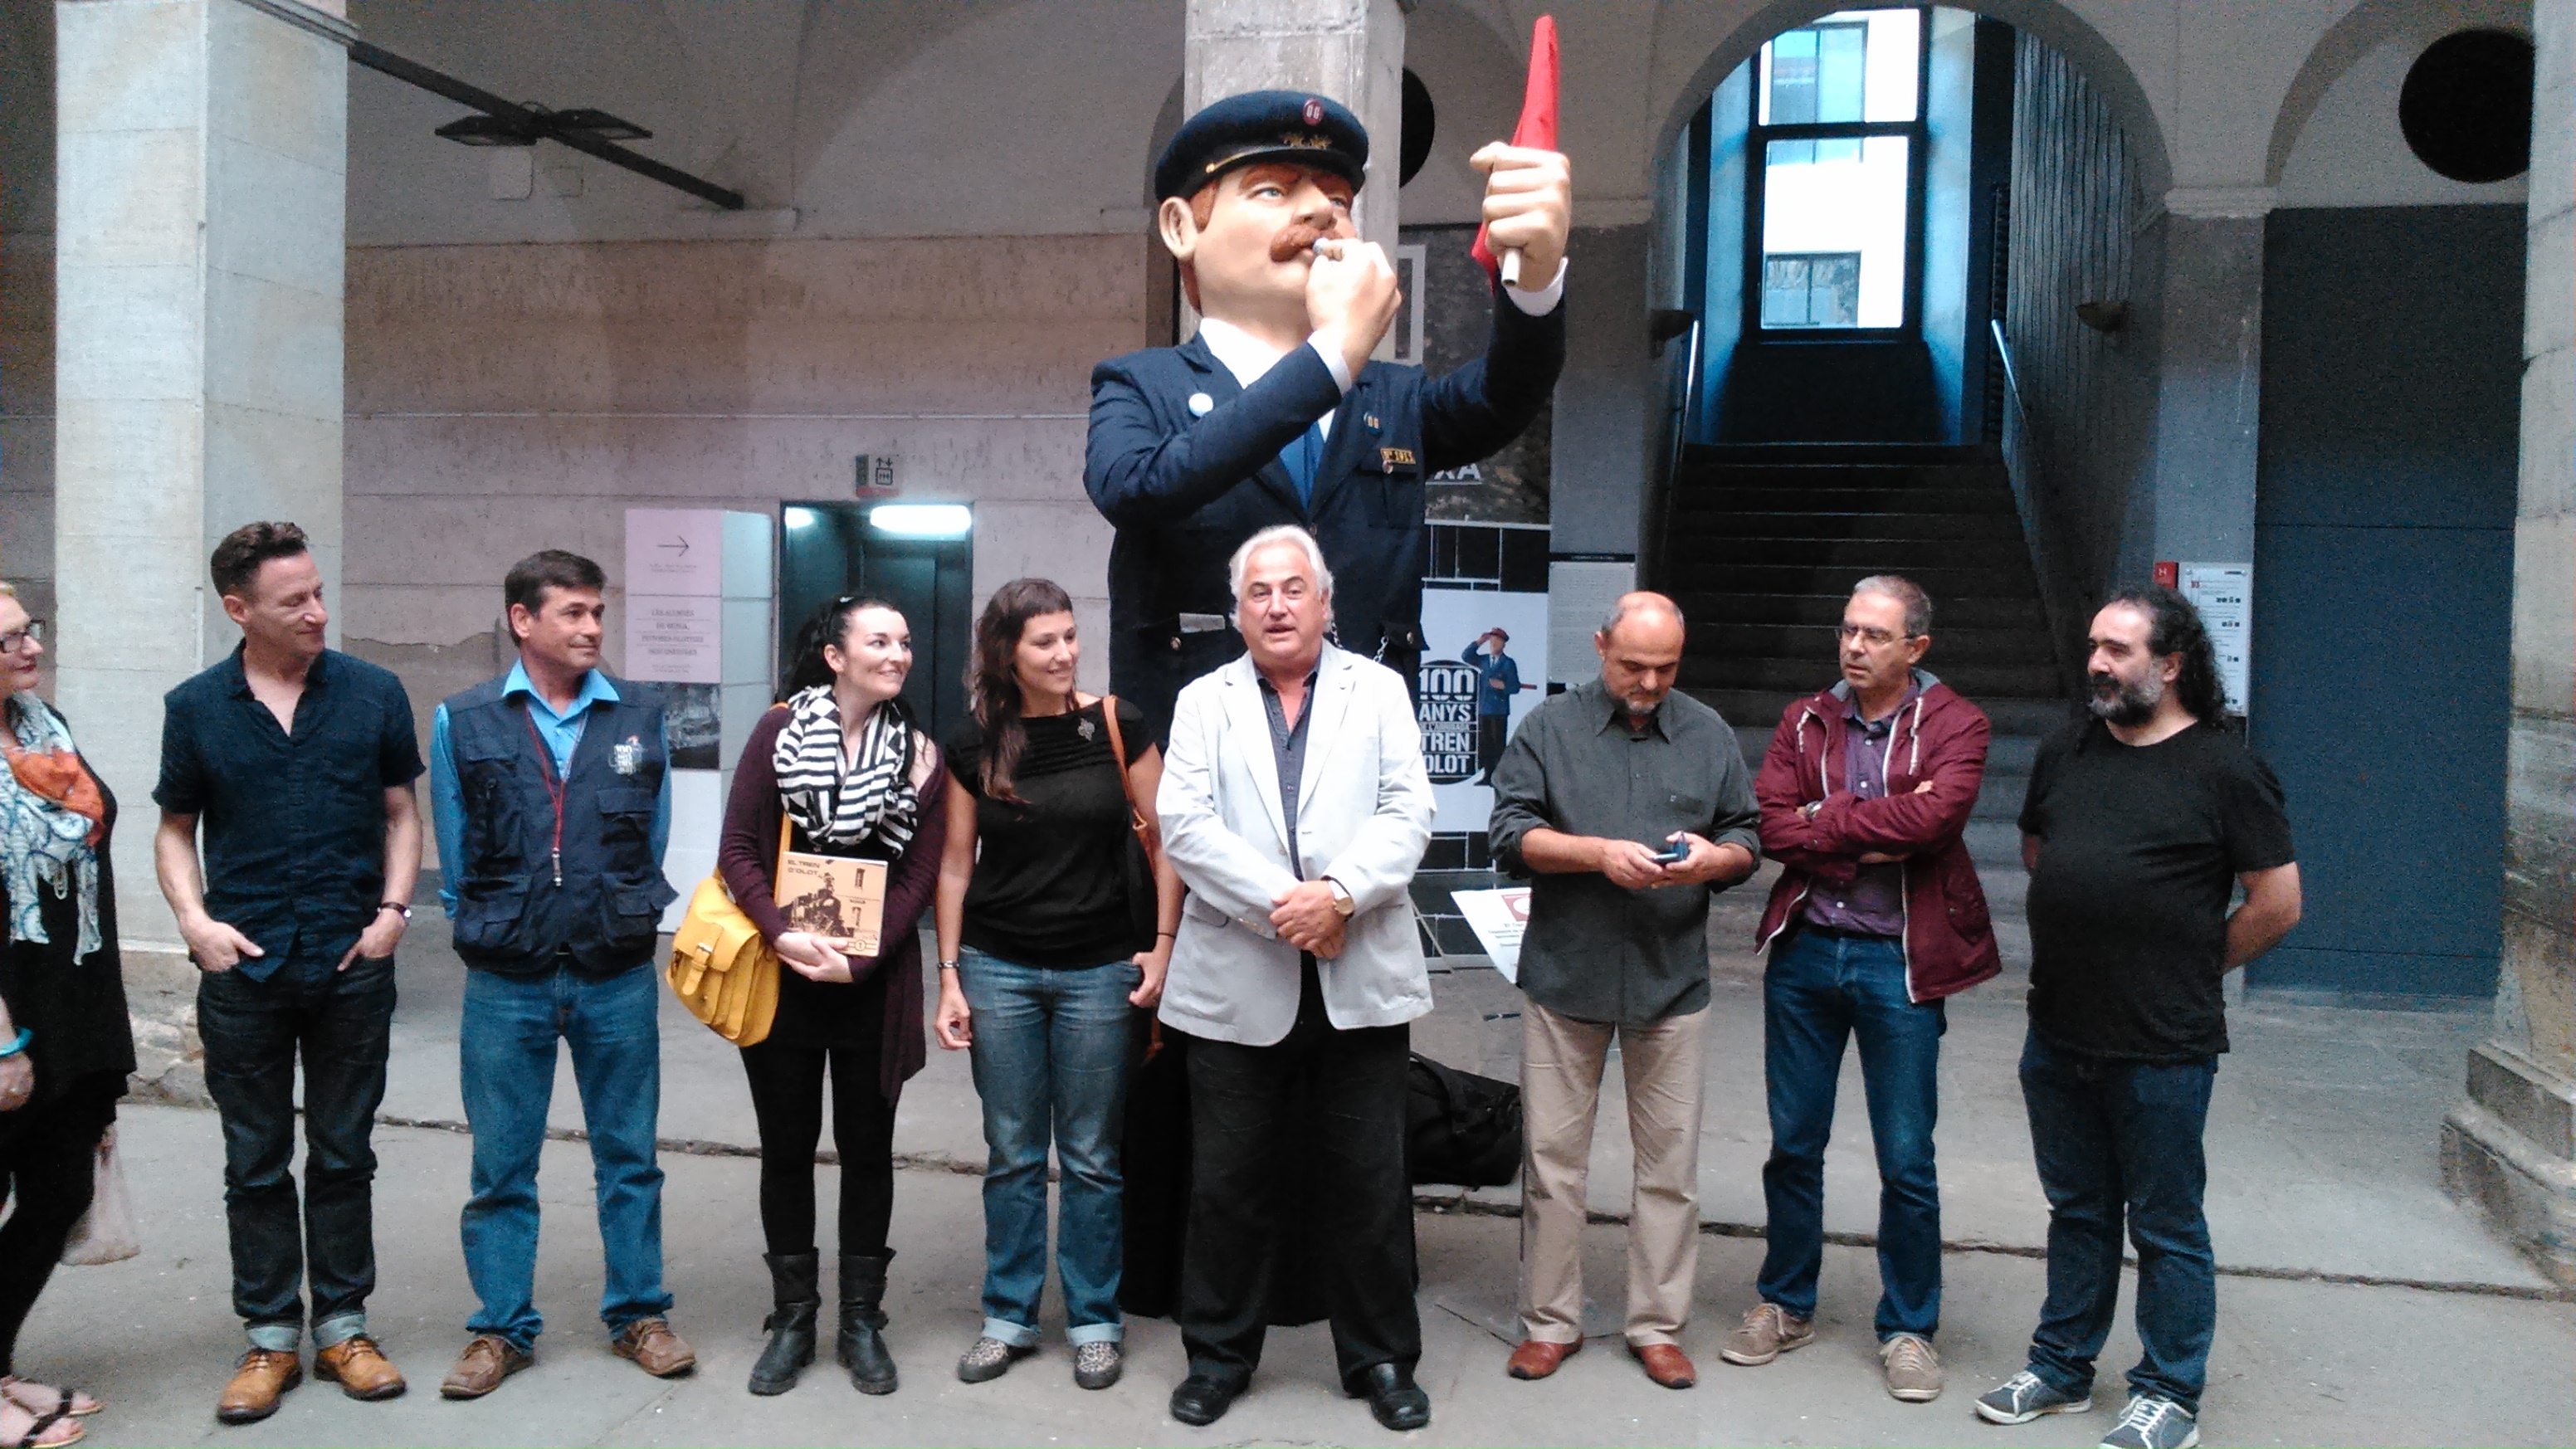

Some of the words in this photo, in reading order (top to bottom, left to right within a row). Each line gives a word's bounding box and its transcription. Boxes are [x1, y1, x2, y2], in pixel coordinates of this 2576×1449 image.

[1419, 668, 1475, 701] 100
[1418, 704, 1471, 722] ANYS
[1421, 732, 1470, 752] TREN
[1424, 754, 1471, 773] OLOT
[798, 861, 821, 869] TREN
